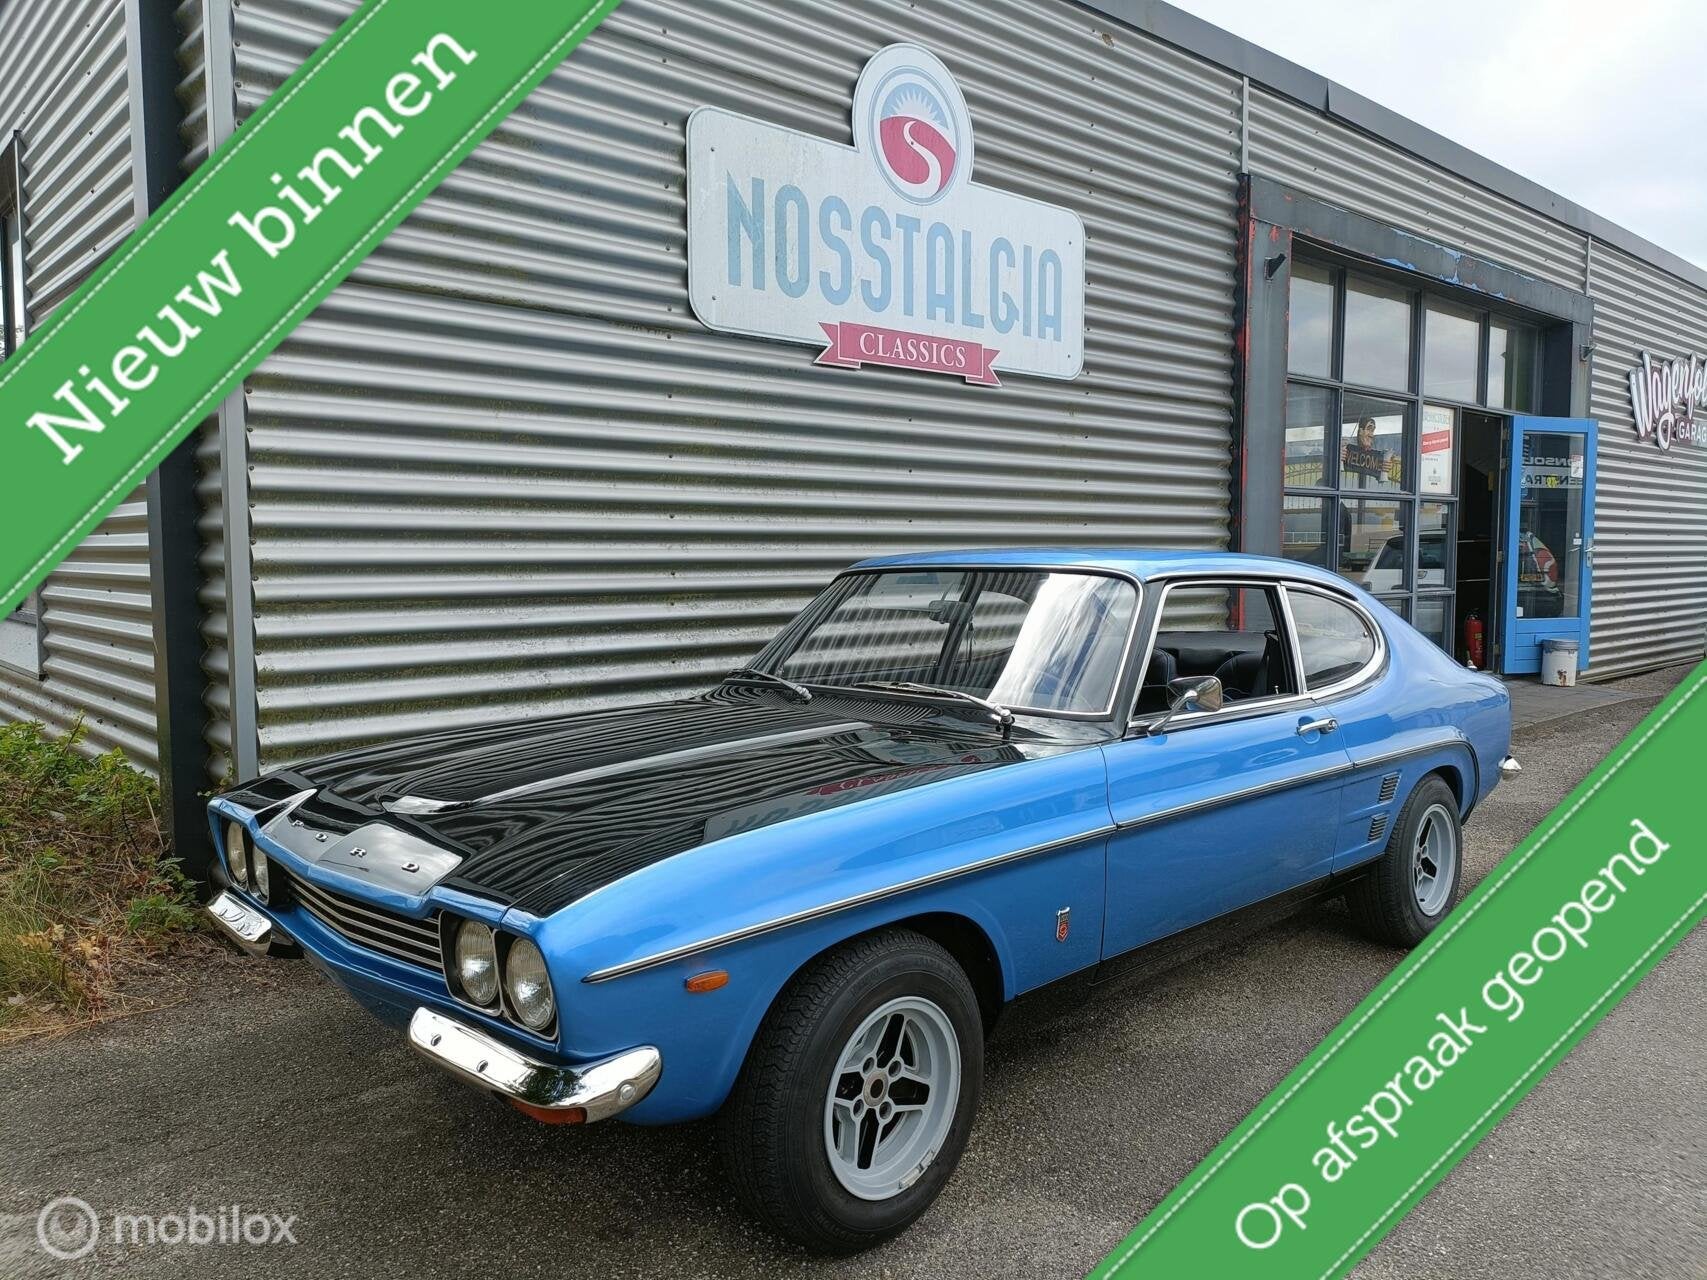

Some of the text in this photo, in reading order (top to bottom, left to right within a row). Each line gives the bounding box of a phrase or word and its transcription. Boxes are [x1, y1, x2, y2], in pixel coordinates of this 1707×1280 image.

[726, 168, 1063, 342] NOSSTALGIA
[859, 332, 967, 369] CLASSICS
[291, 819, 420, 874] FORD
